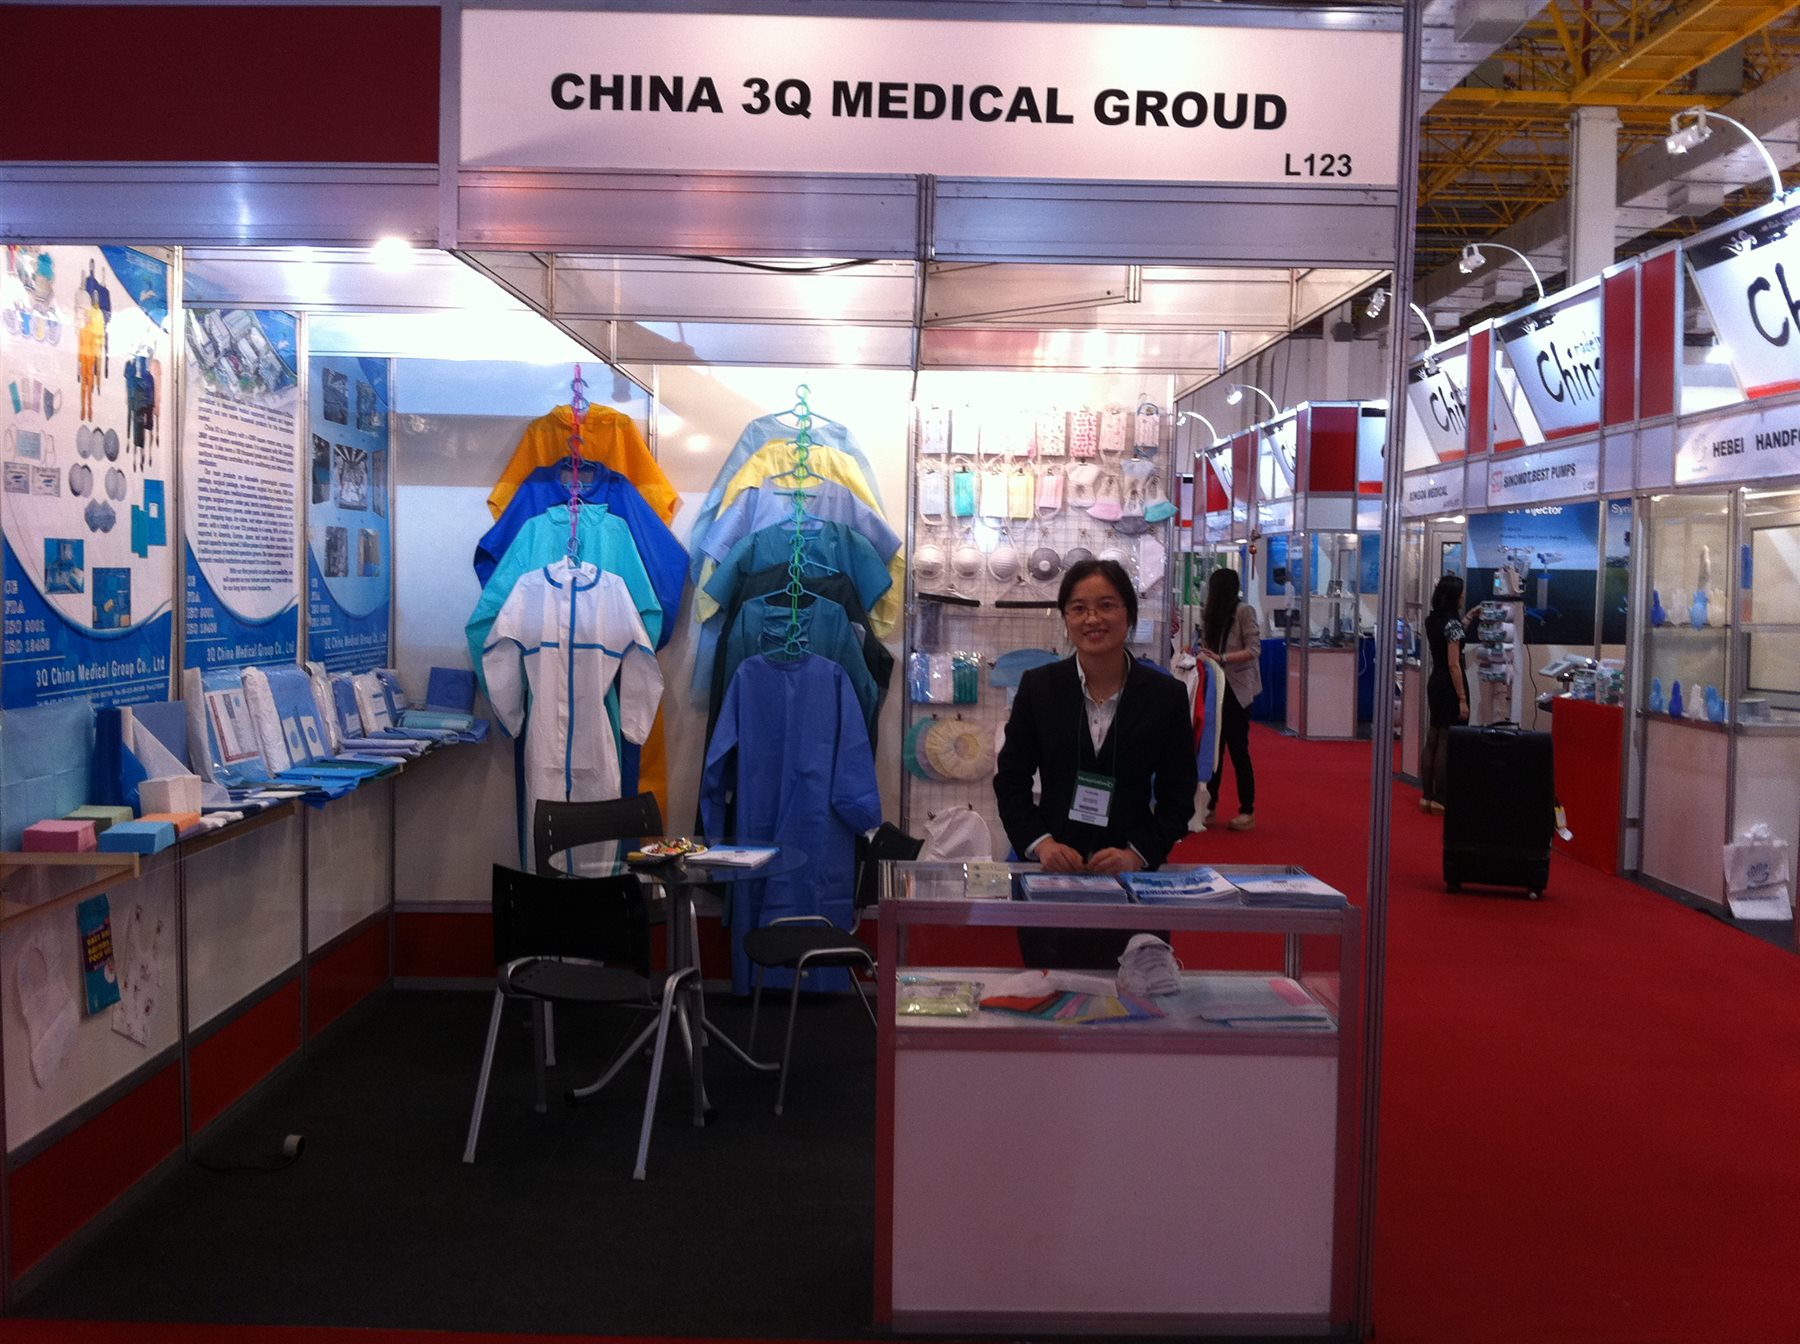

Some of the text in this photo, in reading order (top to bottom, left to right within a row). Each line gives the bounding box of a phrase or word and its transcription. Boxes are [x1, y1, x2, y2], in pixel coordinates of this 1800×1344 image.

[551, 72, 1287, 130] CHINA 3Q MEDICAL GROUD
[1284, 152, 1353, 177] L123
[1712, 428, 1800, 457] HEBEI HANDF
[4, 619, 22, 634] ISO
[4, 639, 23, 654] ISO
[207, 647, 216, 662] 3Q
[217, 646, 234, 661] China
[235, 642, 257, 659] Medical
[258, 642, 274, 658] Group
[36, 668, 48, 687] 3Q
[51, 667, 75, 685] China
[78, 661, 109, 680] Medical
[112, 660, 134, 677] Group
[153, 656, 165, 672] Ltd
